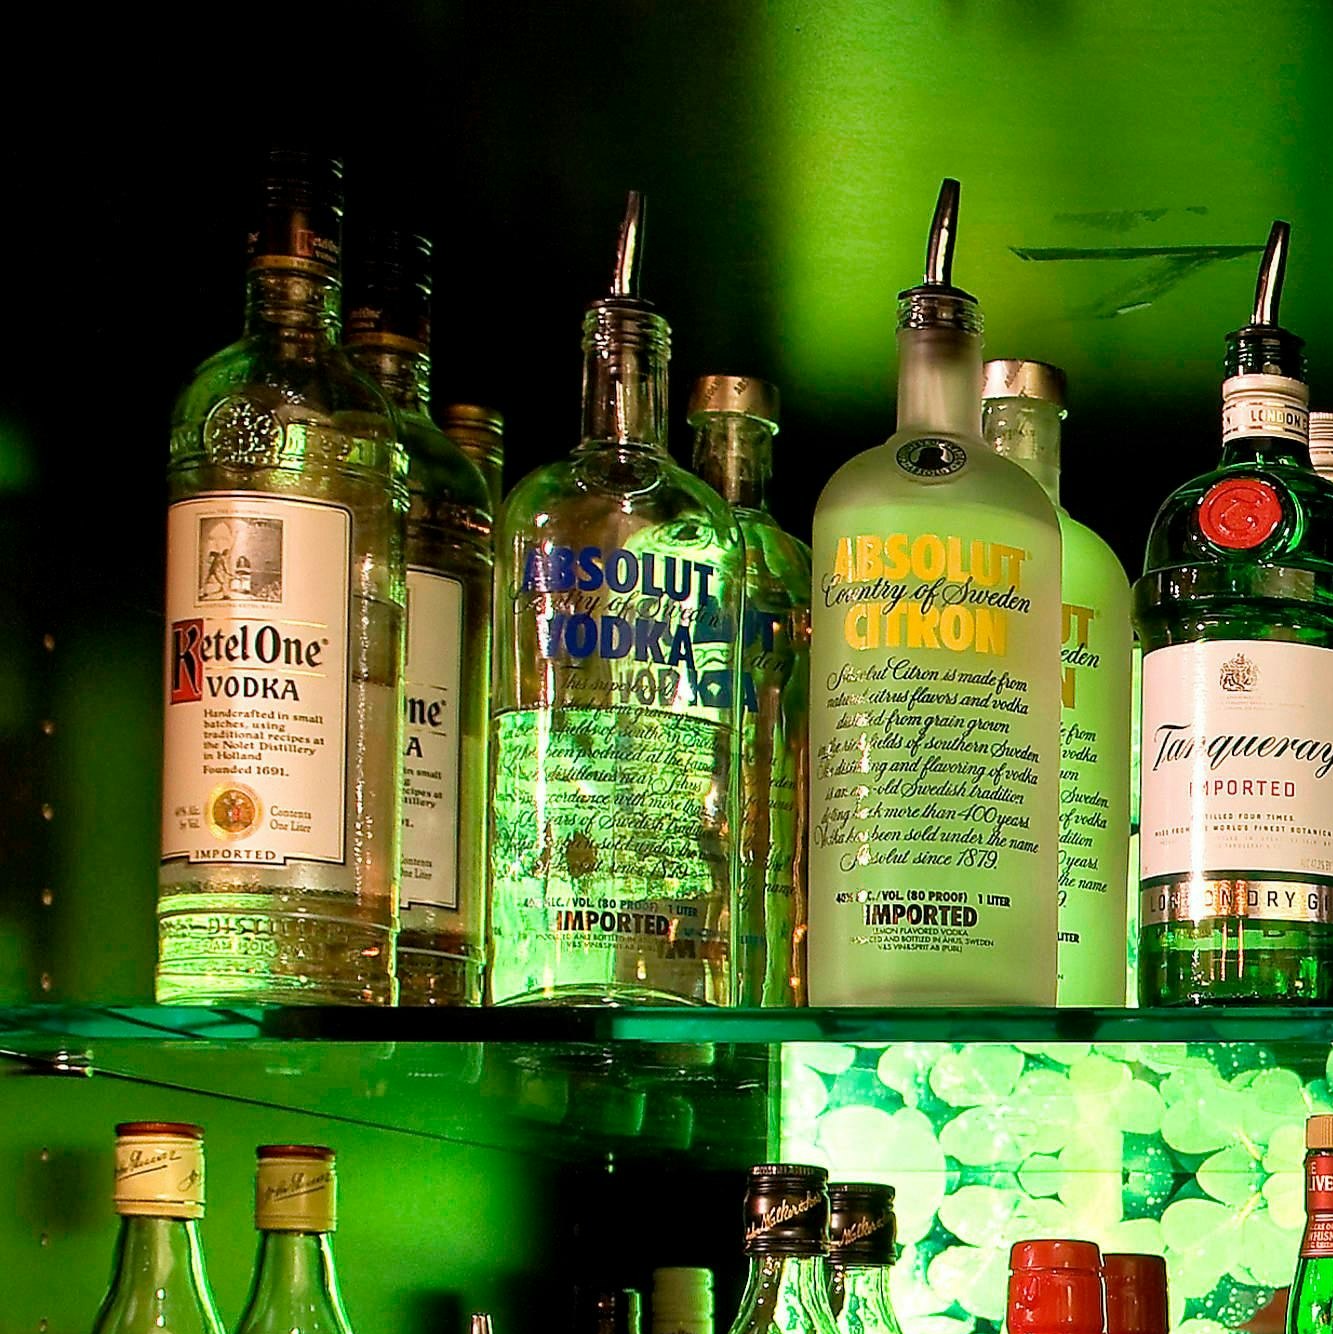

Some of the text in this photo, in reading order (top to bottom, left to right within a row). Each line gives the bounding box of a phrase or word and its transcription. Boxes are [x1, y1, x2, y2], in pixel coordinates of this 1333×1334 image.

[833, 533, 1029, 588] ABSOLUT
[522, 546, 714, 602] ABSOLUT
[822, 573, 1031, 617] Country of Sweden
[845, 604, 1009, 656] CITRON
[172, 622, 321, 697] Ketel One
[888, 656, 939, 681] Citron
[205, 676, 299, 701] VODKA
[992, 693, 1028, 715] vodka
[204, 709, 323, 724] Handcrafted small
[223, 741, 316, 756] Nolet Distillery
[268, 734, 310, 744] recipes
[217, 752, 262, 760] Holland
[924, 736, 1040, 763] southern Sweden
[203, 766, 251, 775] Founded
[900, 780, 966, 798] Swedish
[1254, 825, 1285, 833] FINEST
[196, 850, 276, 859] IMPORTED
[1008, 838, 1039, 854] name
[929, 891, 1010, 907] PROOF) LITER
[1248, 891, 1296, 911] DRY
[557, 911, 671, 935] IMPORTED
[865, 905, 978, 926] IMPORTED
